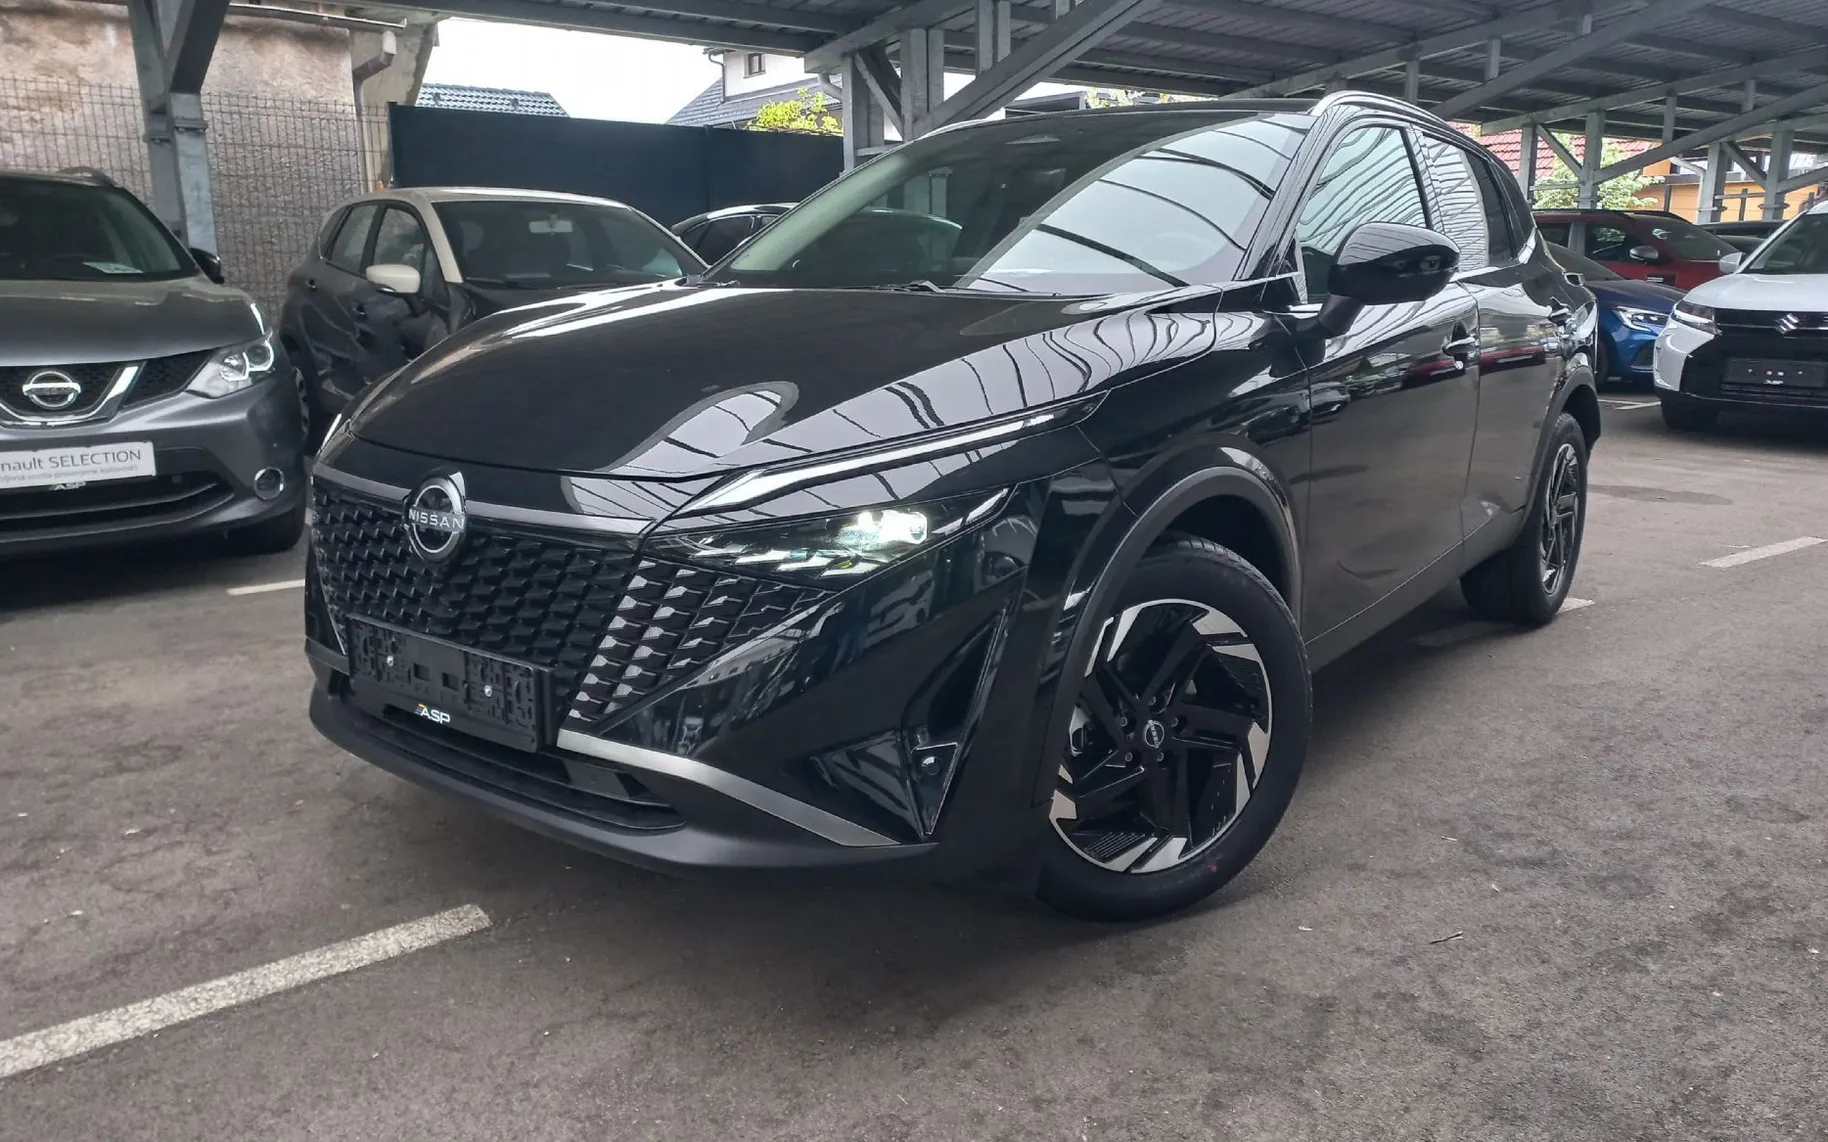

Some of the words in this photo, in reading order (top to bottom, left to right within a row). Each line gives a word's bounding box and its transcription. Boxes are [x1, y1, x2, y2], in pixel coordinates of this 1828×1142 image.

[48, 449, 141, 469] SELECTION
[408, 508, 465, 530] NISSAN
[420, 706, 450, 724] ASP
